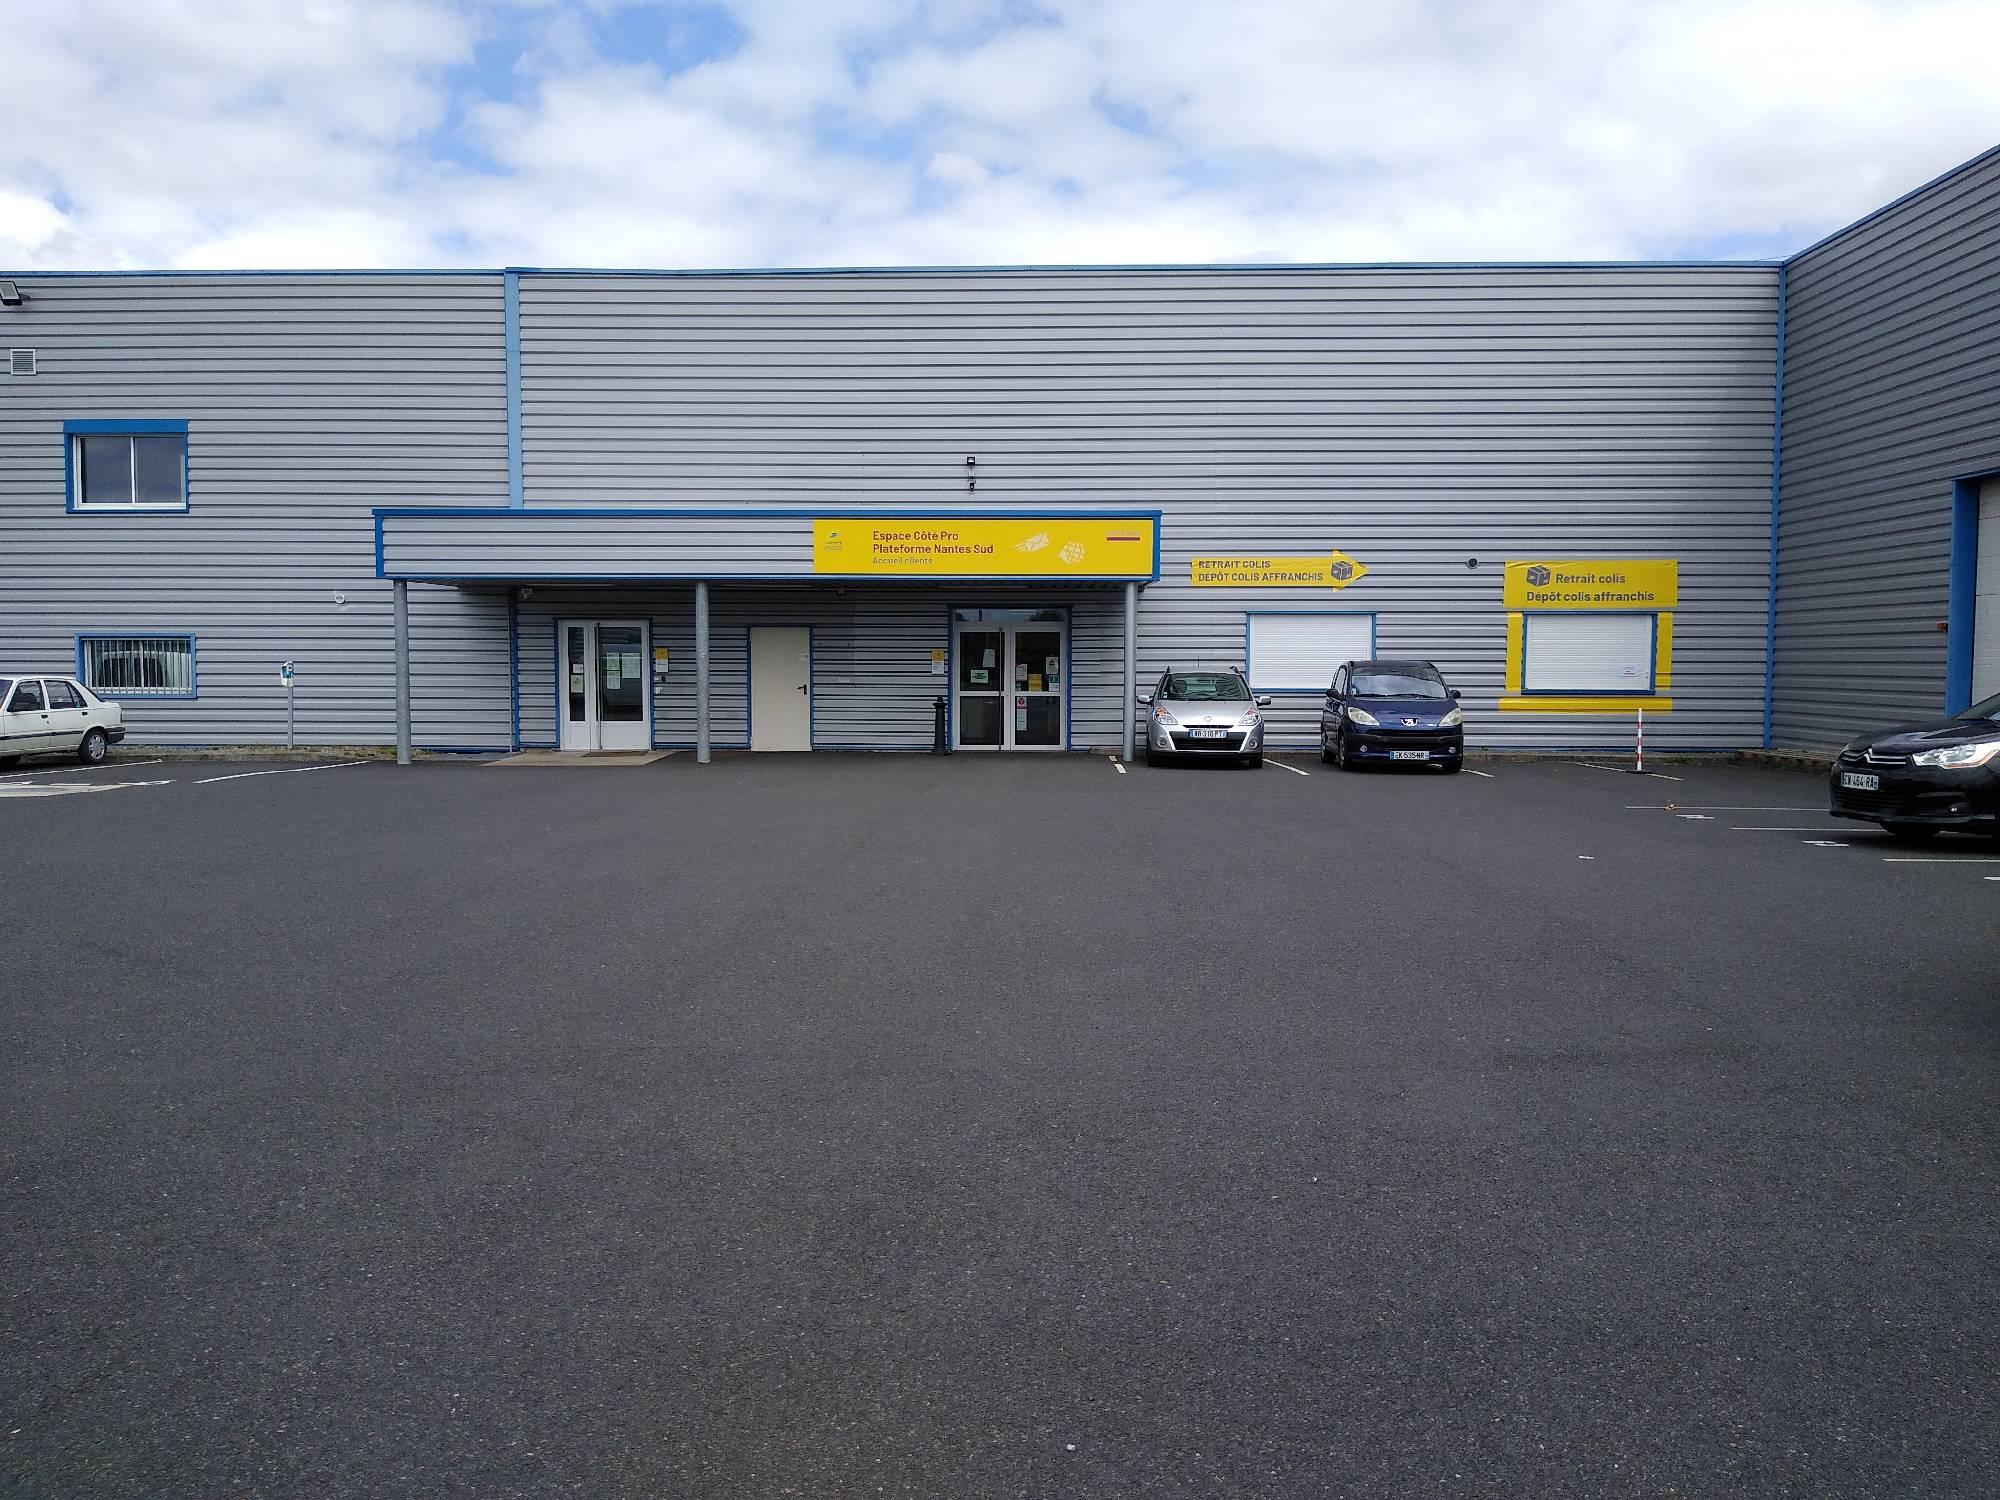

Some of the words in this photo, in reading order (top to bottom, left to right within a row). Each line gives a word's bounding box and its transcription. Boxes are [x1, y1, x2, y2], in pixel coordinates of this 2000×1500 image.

[873, 530, 911, 542] Espace
[914, 530, 938, 541] Côté
[940, 531, 959, 541] Pro
[873, 544, 931, 554] Plateforme
[934, 544, 971, 554] Nantes
[974, 544, 994, 554] Sud
[872, 556, 903, 565] Accueil
[904, 556, 933, 565] clients
[1198, 560, 1240, 569] RETRAIT
[1242, 560, 1271, 569] COLIS
[1231, 572, 1260, 582] COLIS
[1261, 572, 1324, 581] AFFRANCHIS
[1555, 573, 1596, 584] Retrait
[1598, 573, 1626, 584] colis
[1527, 591, 1561, 604] Dépôt
[1563, 591, 1591, 602] colis
[1593, 590, 1655, 602] affranchis
